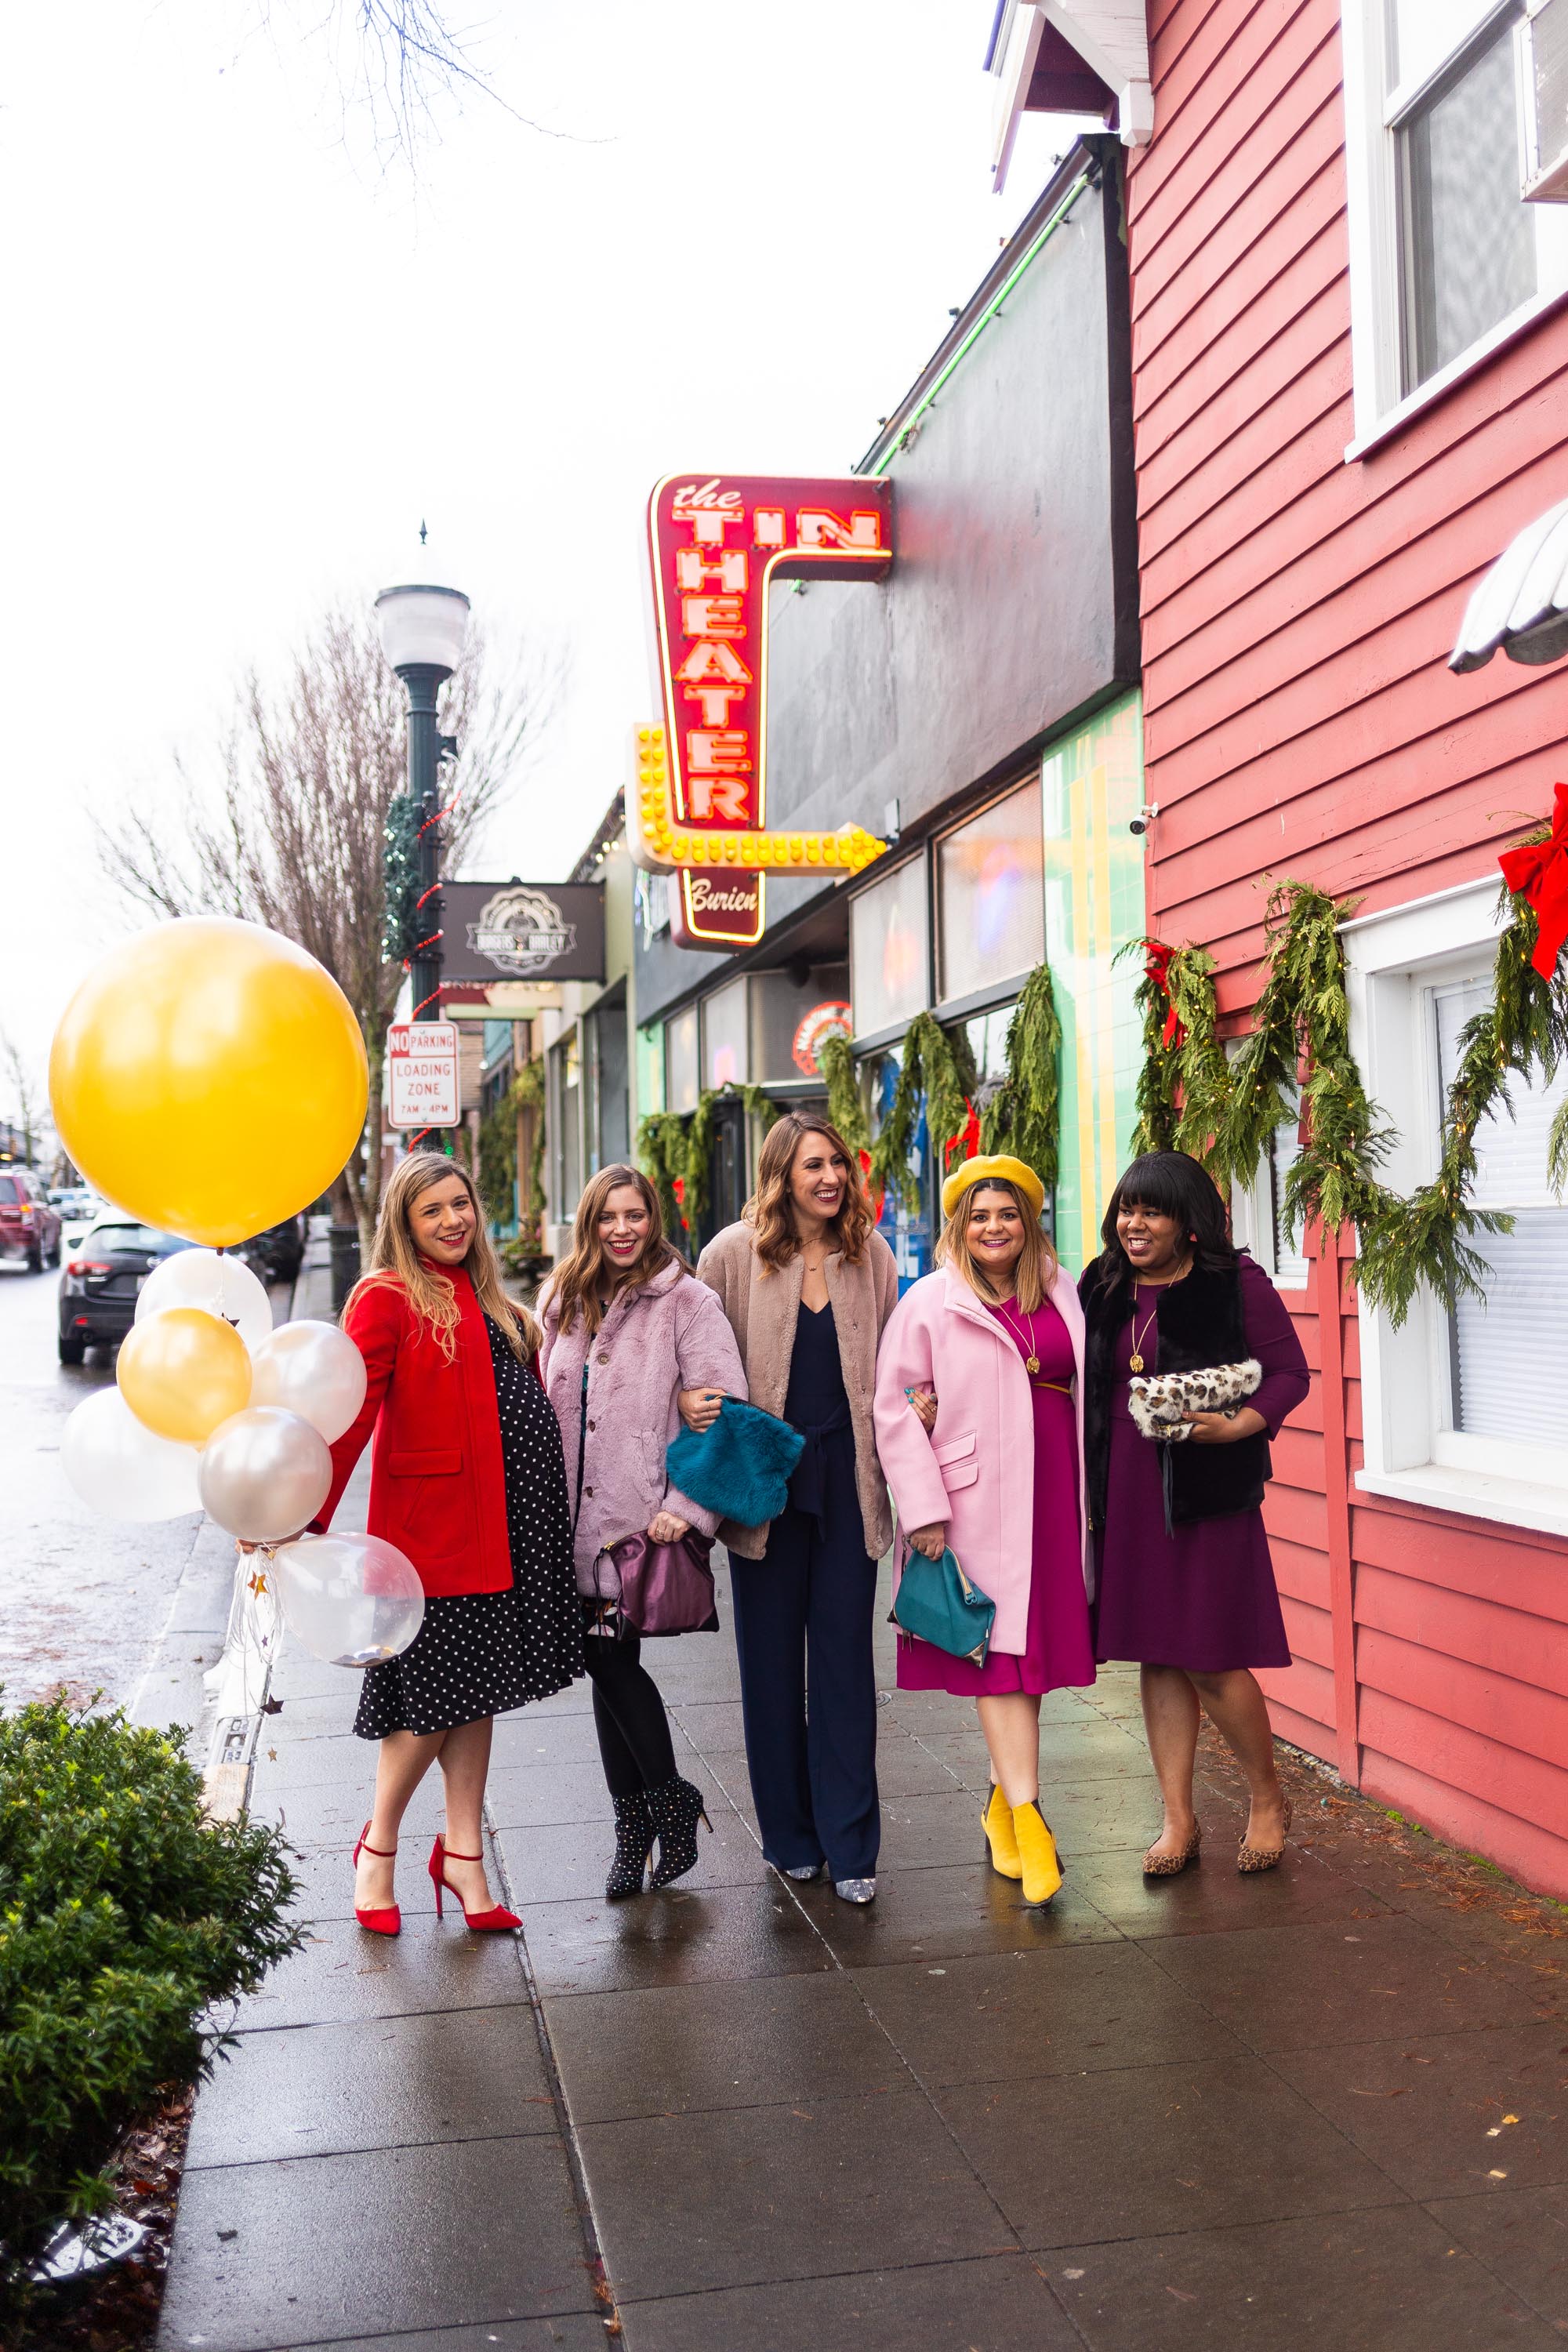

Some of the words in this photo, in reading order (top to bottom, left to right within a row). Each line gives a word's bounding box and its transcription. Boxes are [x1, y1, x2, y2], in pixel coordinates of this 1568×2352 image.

[673, 478, 742, 508] the
[672, 506, 880, 549] TIN
[672, 506, 753, 821] THEATER
[691, 878, 759, 912] Burien
[390, 1031, 409, 1052] NO
[411, 1035, 452, 1048] PARKING
[397, 1064, 450, 1077] LOADING
[408, 1083, 441, 1096] ZONE
[401, 1105, 419, 1113] 7AM
[429, 1104, 448, 1113] 4PM
